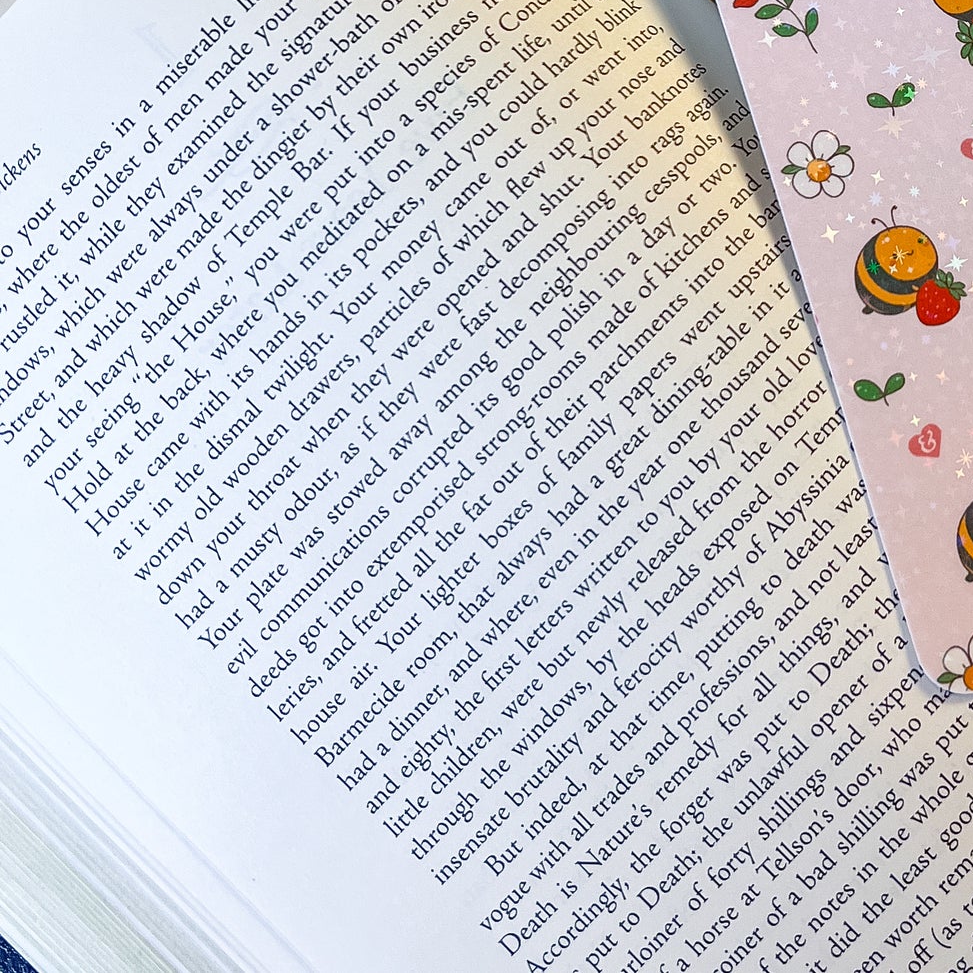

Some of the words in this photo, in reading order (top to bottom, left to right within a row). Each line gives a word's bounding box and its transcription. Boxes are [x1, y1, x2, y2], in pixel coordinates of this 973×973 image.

[6, 243, 60, 295] where
[59, 210, 91, 242] the
[91, 154, 142, 209] oldest
[142, 123, 164, 155] of
[163, 92, 205, 134] men
[204, 42, 255, 92] made
[259, 504, 391, 642] communications
[392, 413, 475, 504] corrupted
[470, 392, 500, 419] its
[500, 339, 548, 398] good
[546, 288, 604, 351] polish
[373, 612, 423, 655] Your
[419, 551, 481, 612] lighter
[477, 498, 534, 550] boxes
[537, 463, 559, 496] of
[556, 412, 617, 472] family
[618, 351, 678, 418] papers
[678, 300, 727, 346] went
[482, 839, 524, 878] But
[520, 774, 588, 841] indeed,
[588, 752, 610, 776] at
[609, 712, 649, 753] that
[648, 670, 696, 713] time,
[694, 596, 765, 673] putting
[759, 574, 783, 597] to
[783, 517, 836, 571] death
[497, 900, 559, 958] Death
[555, 879, 579, 900] is
[573, 803, 653, 879] Nature's
[654, 735, 720, 803] remedy
[716, 703, 749, 736] for
[752, 670, 778, 703] all
[778, 616, 840, 674] things,
[840, 564, 878, 610] and
